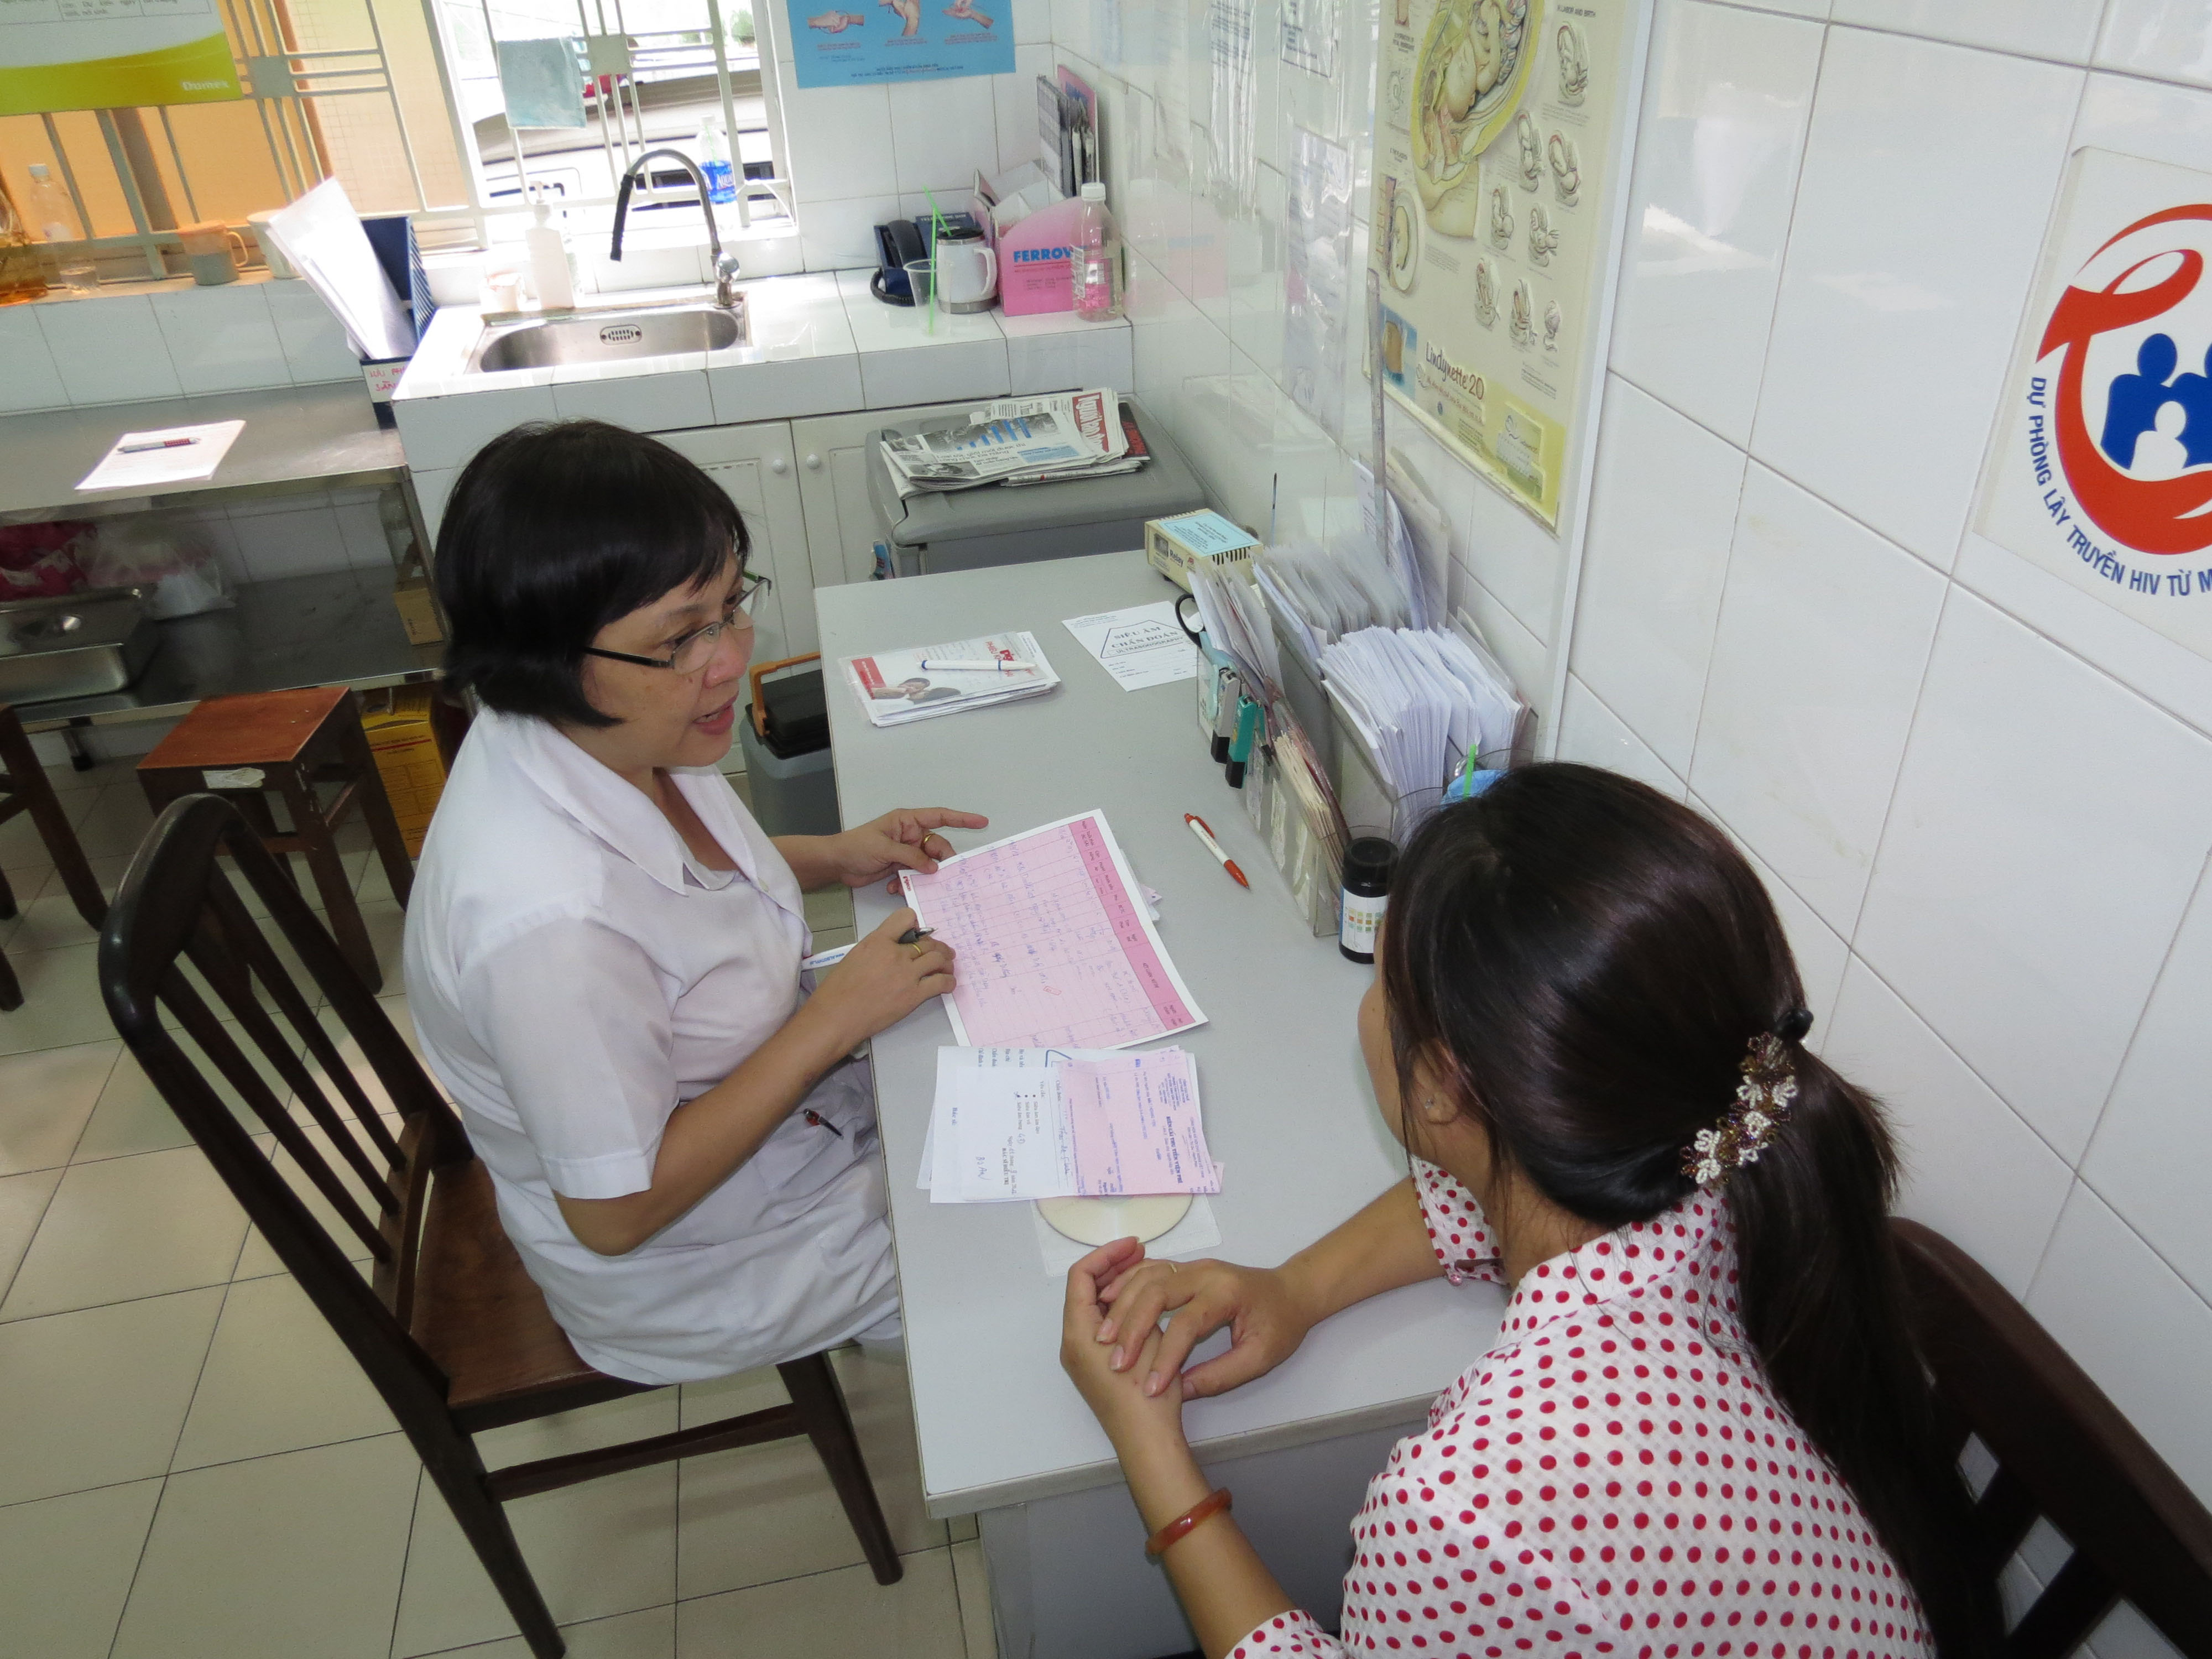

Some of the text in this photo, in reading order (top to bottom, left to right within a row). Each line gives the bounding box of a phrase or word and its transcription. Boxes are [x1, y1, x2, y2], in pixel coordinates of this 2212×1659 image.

[1014, 246, 1072, 263] FERROV
[1468, 374, 1484, 400] 20
[2027, 377, 2212, 597] DỰ PHÒNG LÂY TRUYỀN HIV TỪ M
